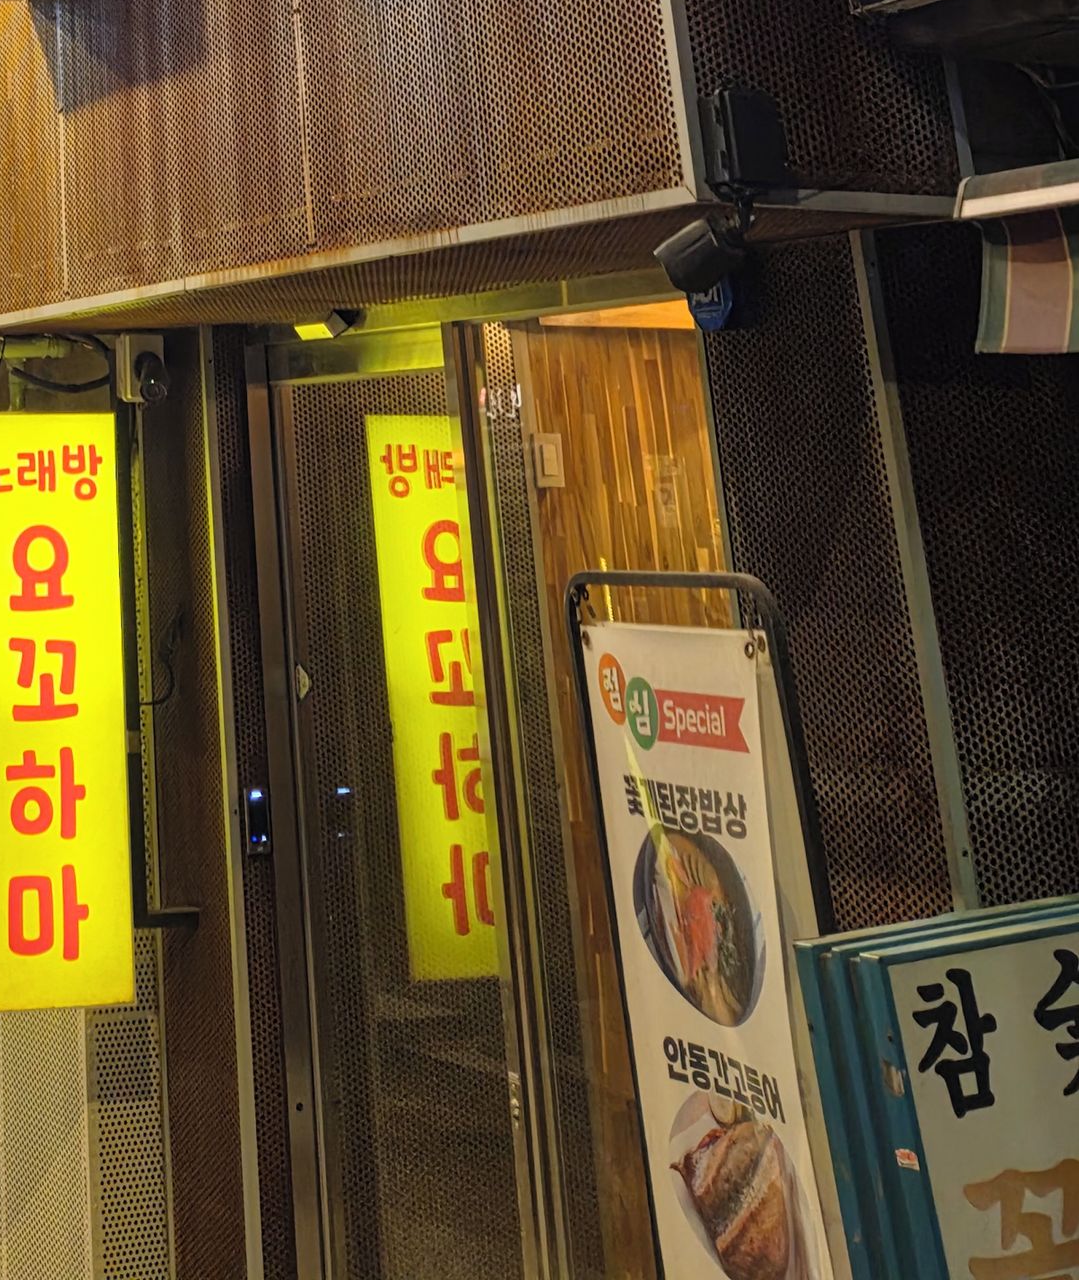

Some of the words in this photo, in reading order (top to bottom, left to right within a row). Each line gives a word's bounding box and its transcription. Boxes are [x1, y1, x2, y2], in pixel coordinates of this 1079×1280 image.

[6, 524, 90, 962] 요꼬하마
[663, 699, 726, 739] Special
[663, 1035, 786, 1124] 안동간고등어
